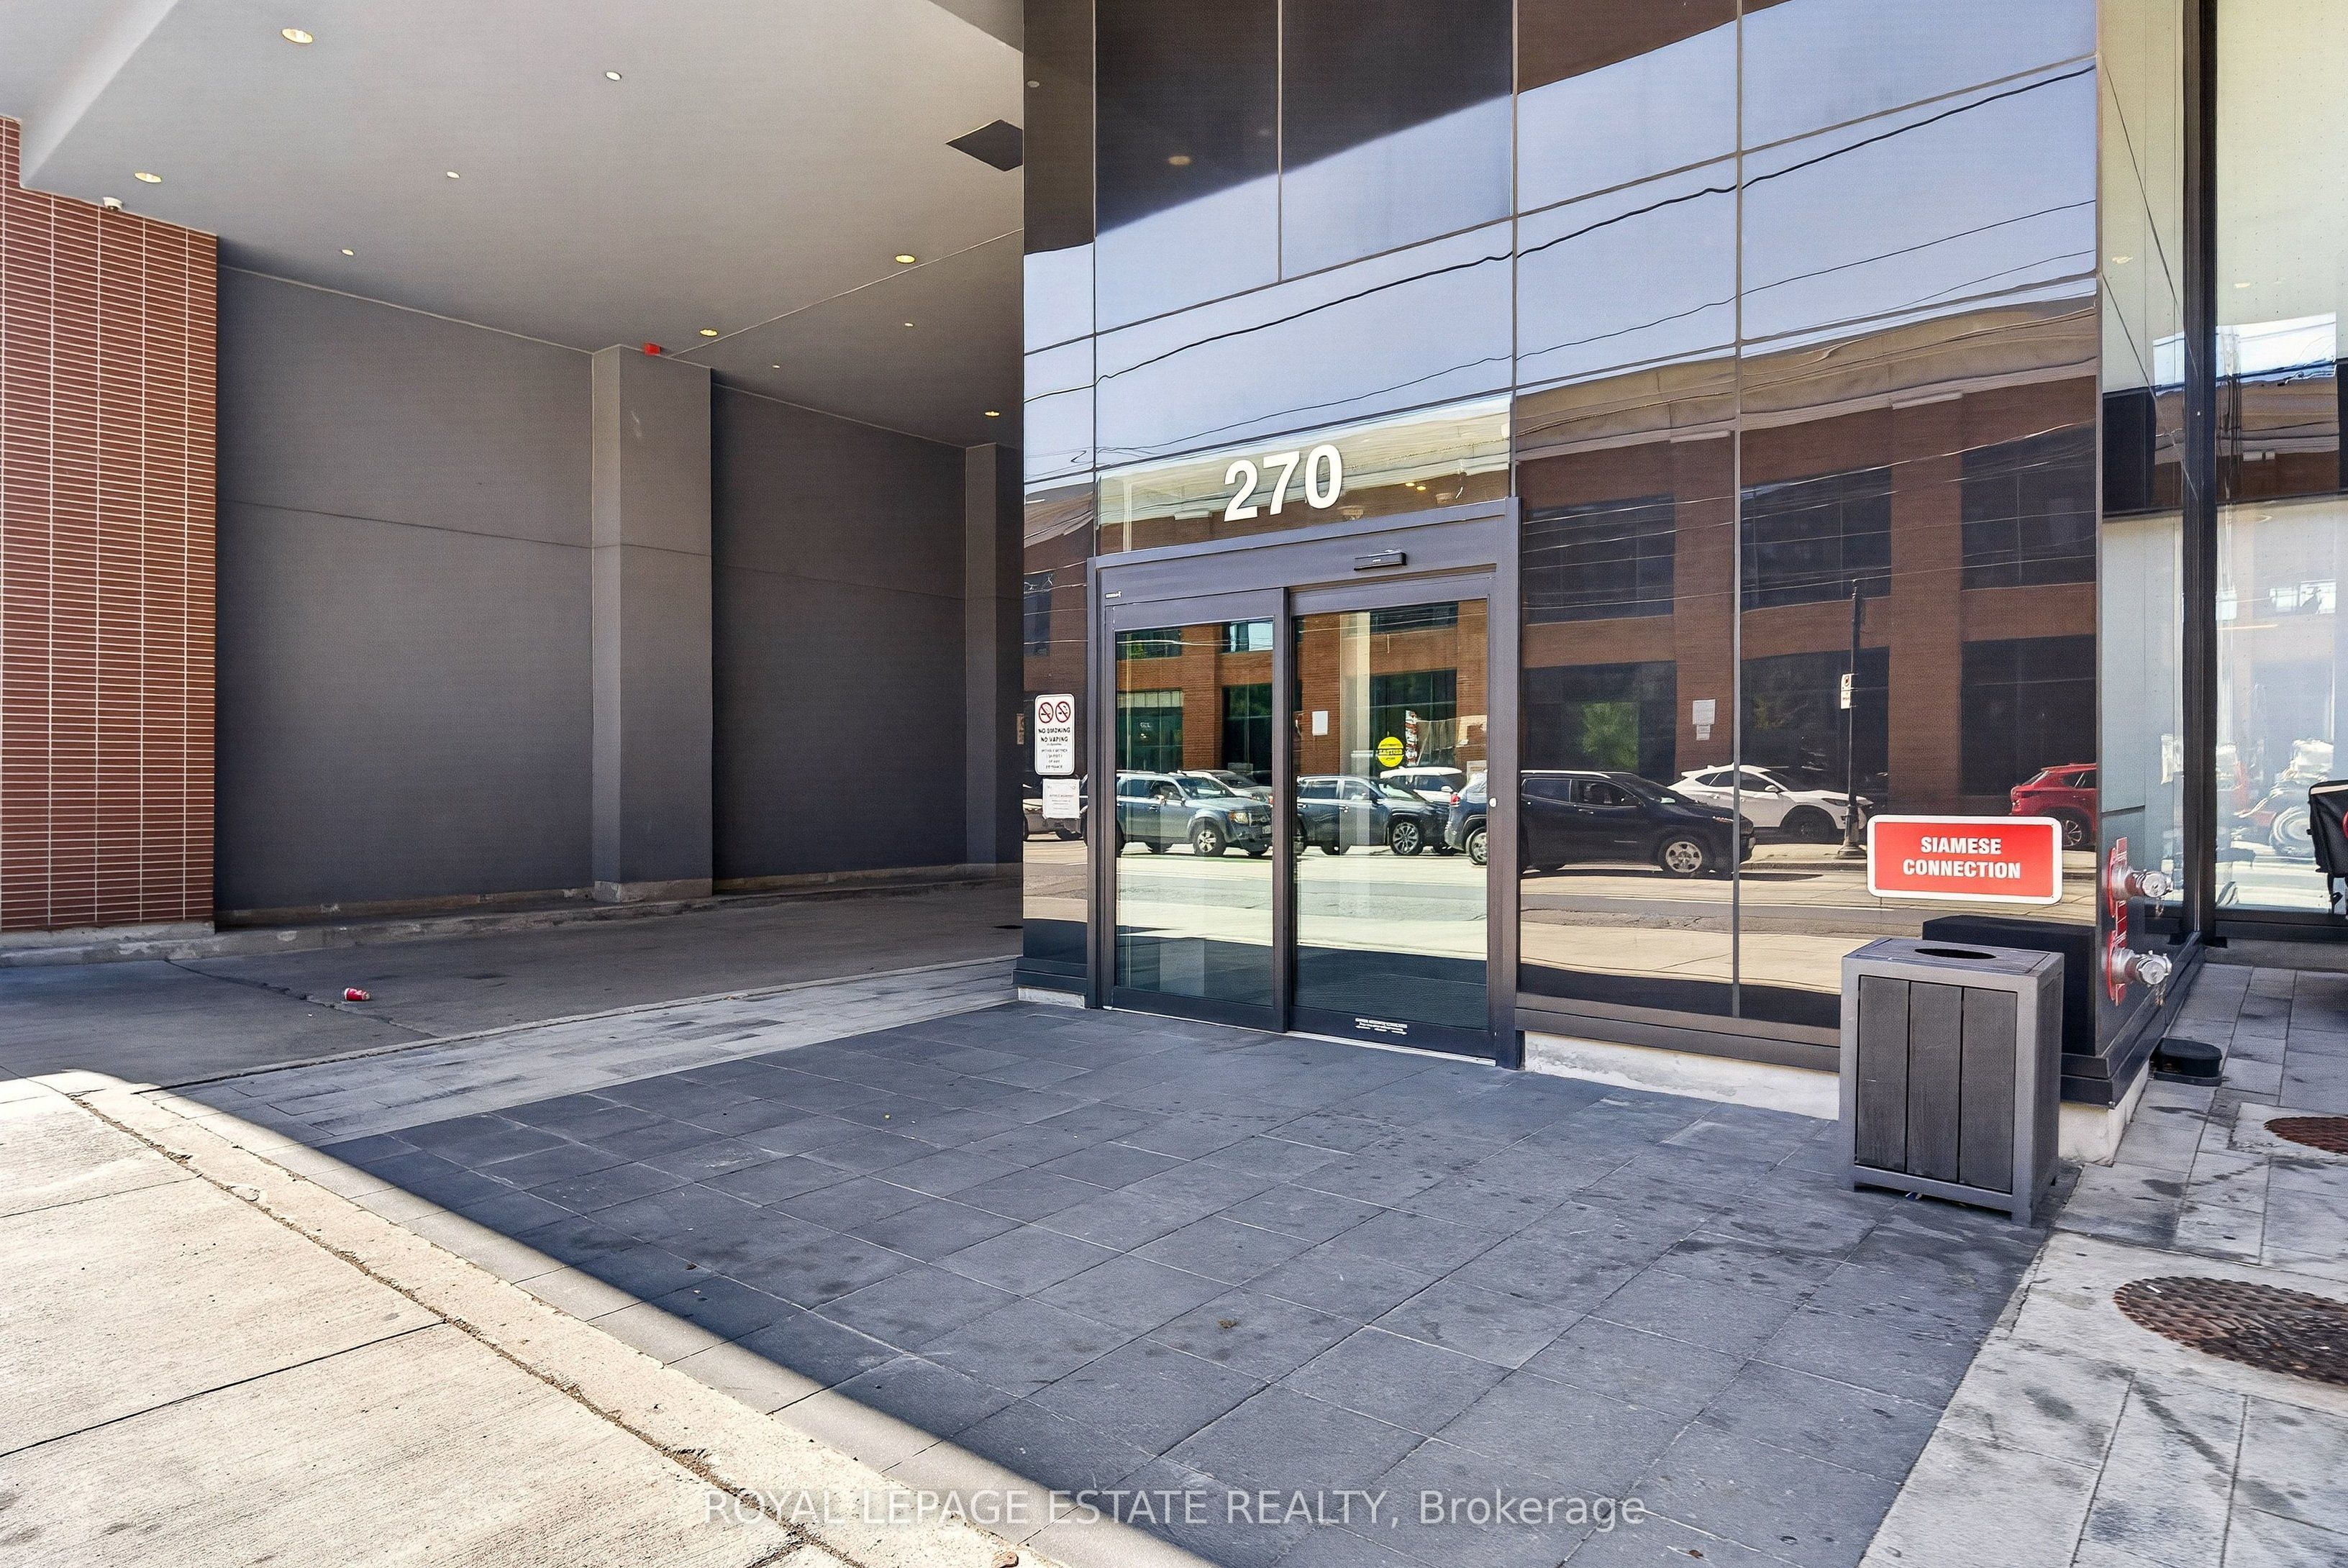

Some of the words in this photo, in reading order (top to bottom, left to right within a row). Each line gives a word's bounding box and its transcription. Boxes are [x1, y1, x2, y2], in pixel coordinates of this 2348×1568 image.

[1224, 445, 1342, 521] 270
[1921, 837, 2002, 854] SIAMESE
[1903, 859, 2021, 879] CONNECTION
